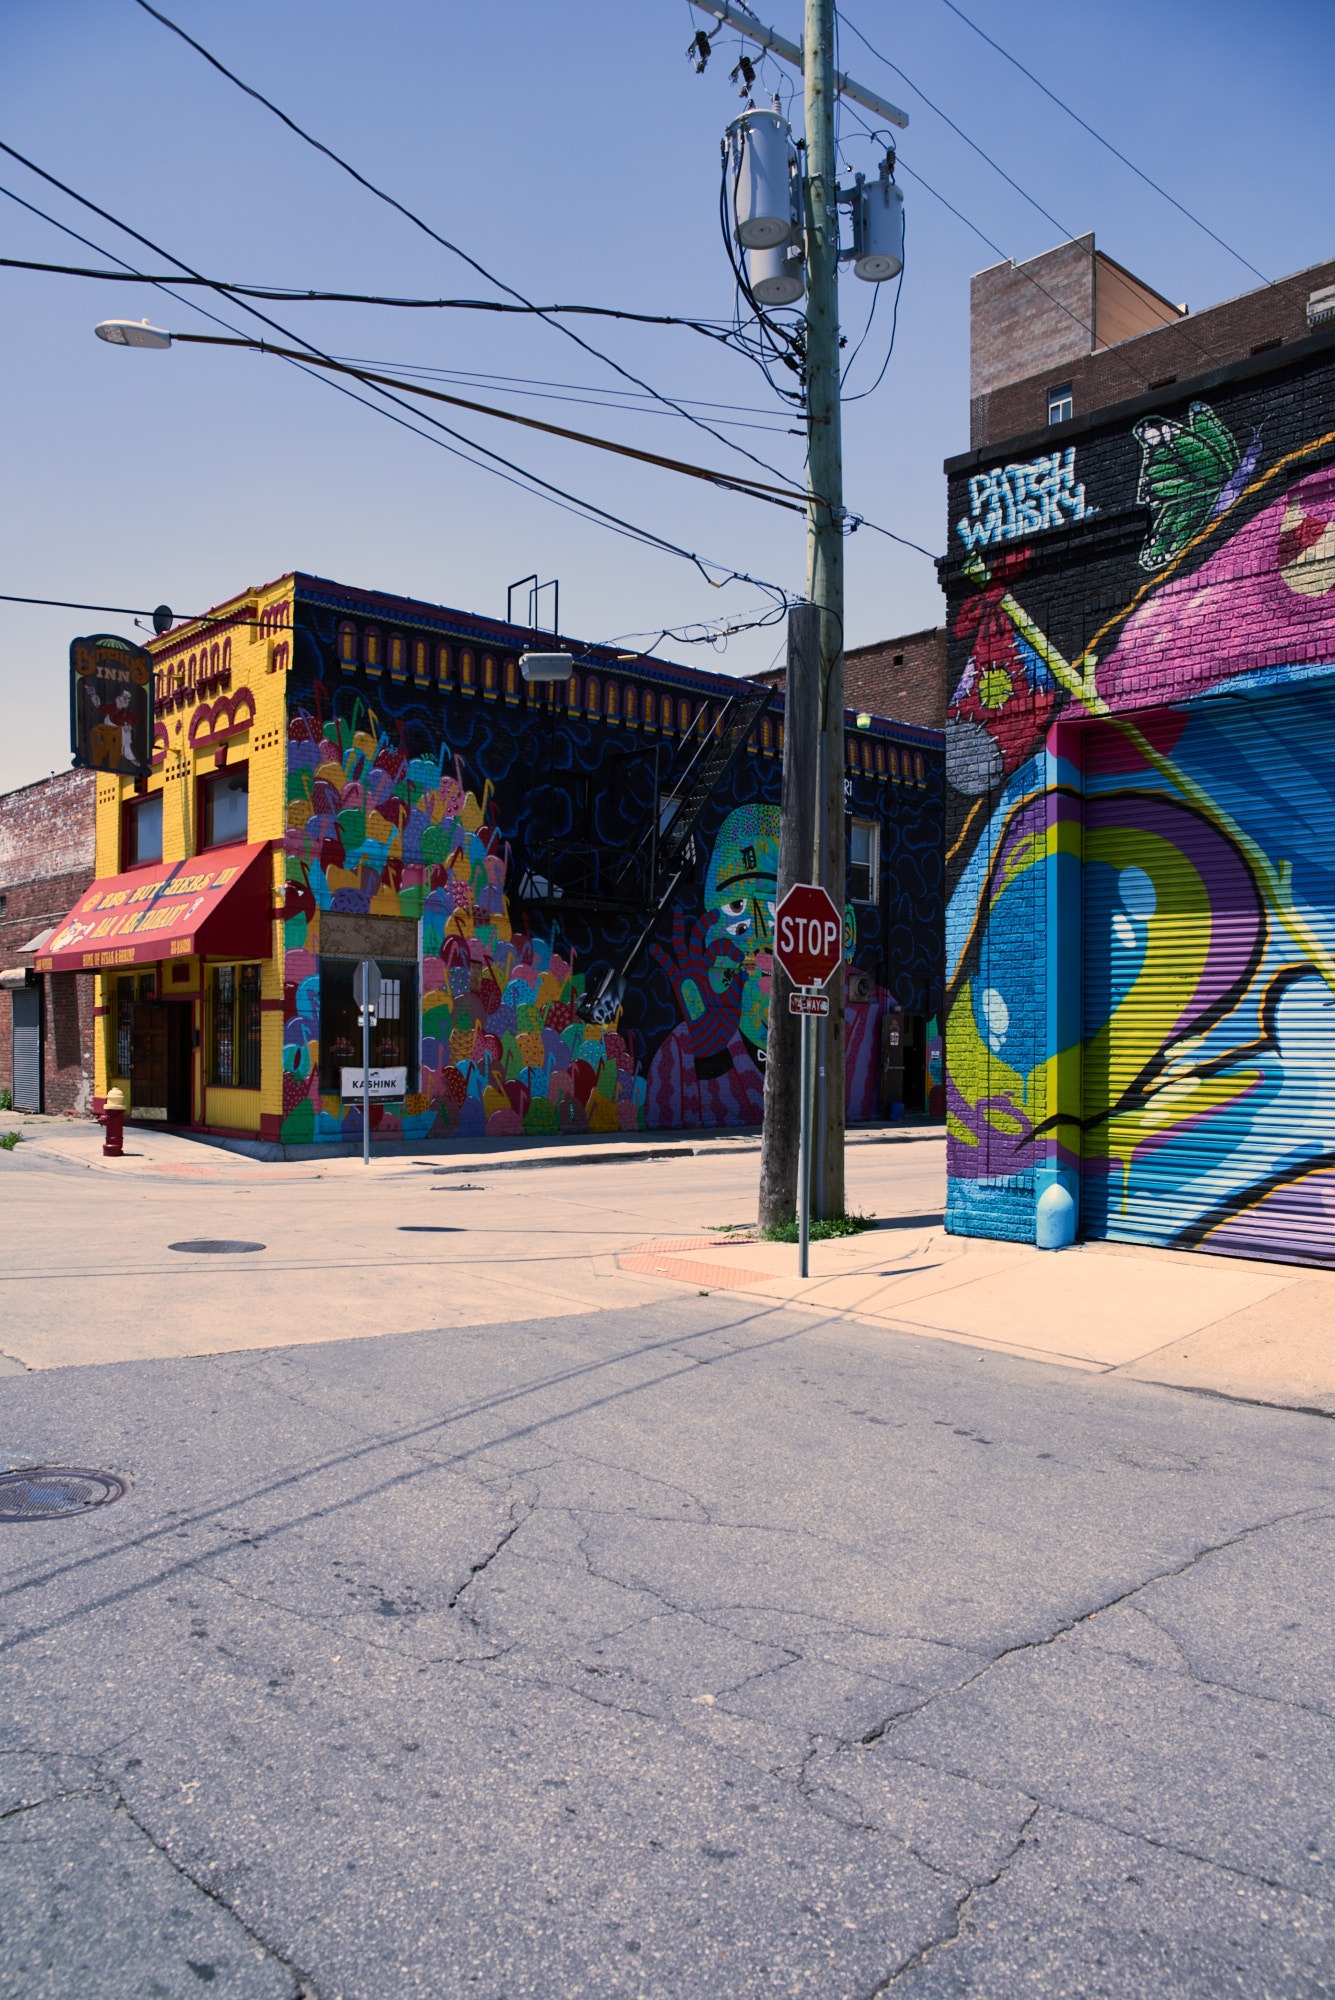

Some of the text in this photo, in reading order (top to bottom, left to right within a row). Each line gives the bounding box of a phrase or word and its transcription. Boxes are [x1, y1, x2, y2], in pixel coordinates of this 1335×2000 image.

[96, 666, 130, 682] INN
[780, 915, 838, 957] STOP
[352, 1080, 397, 1089] KASHINK
